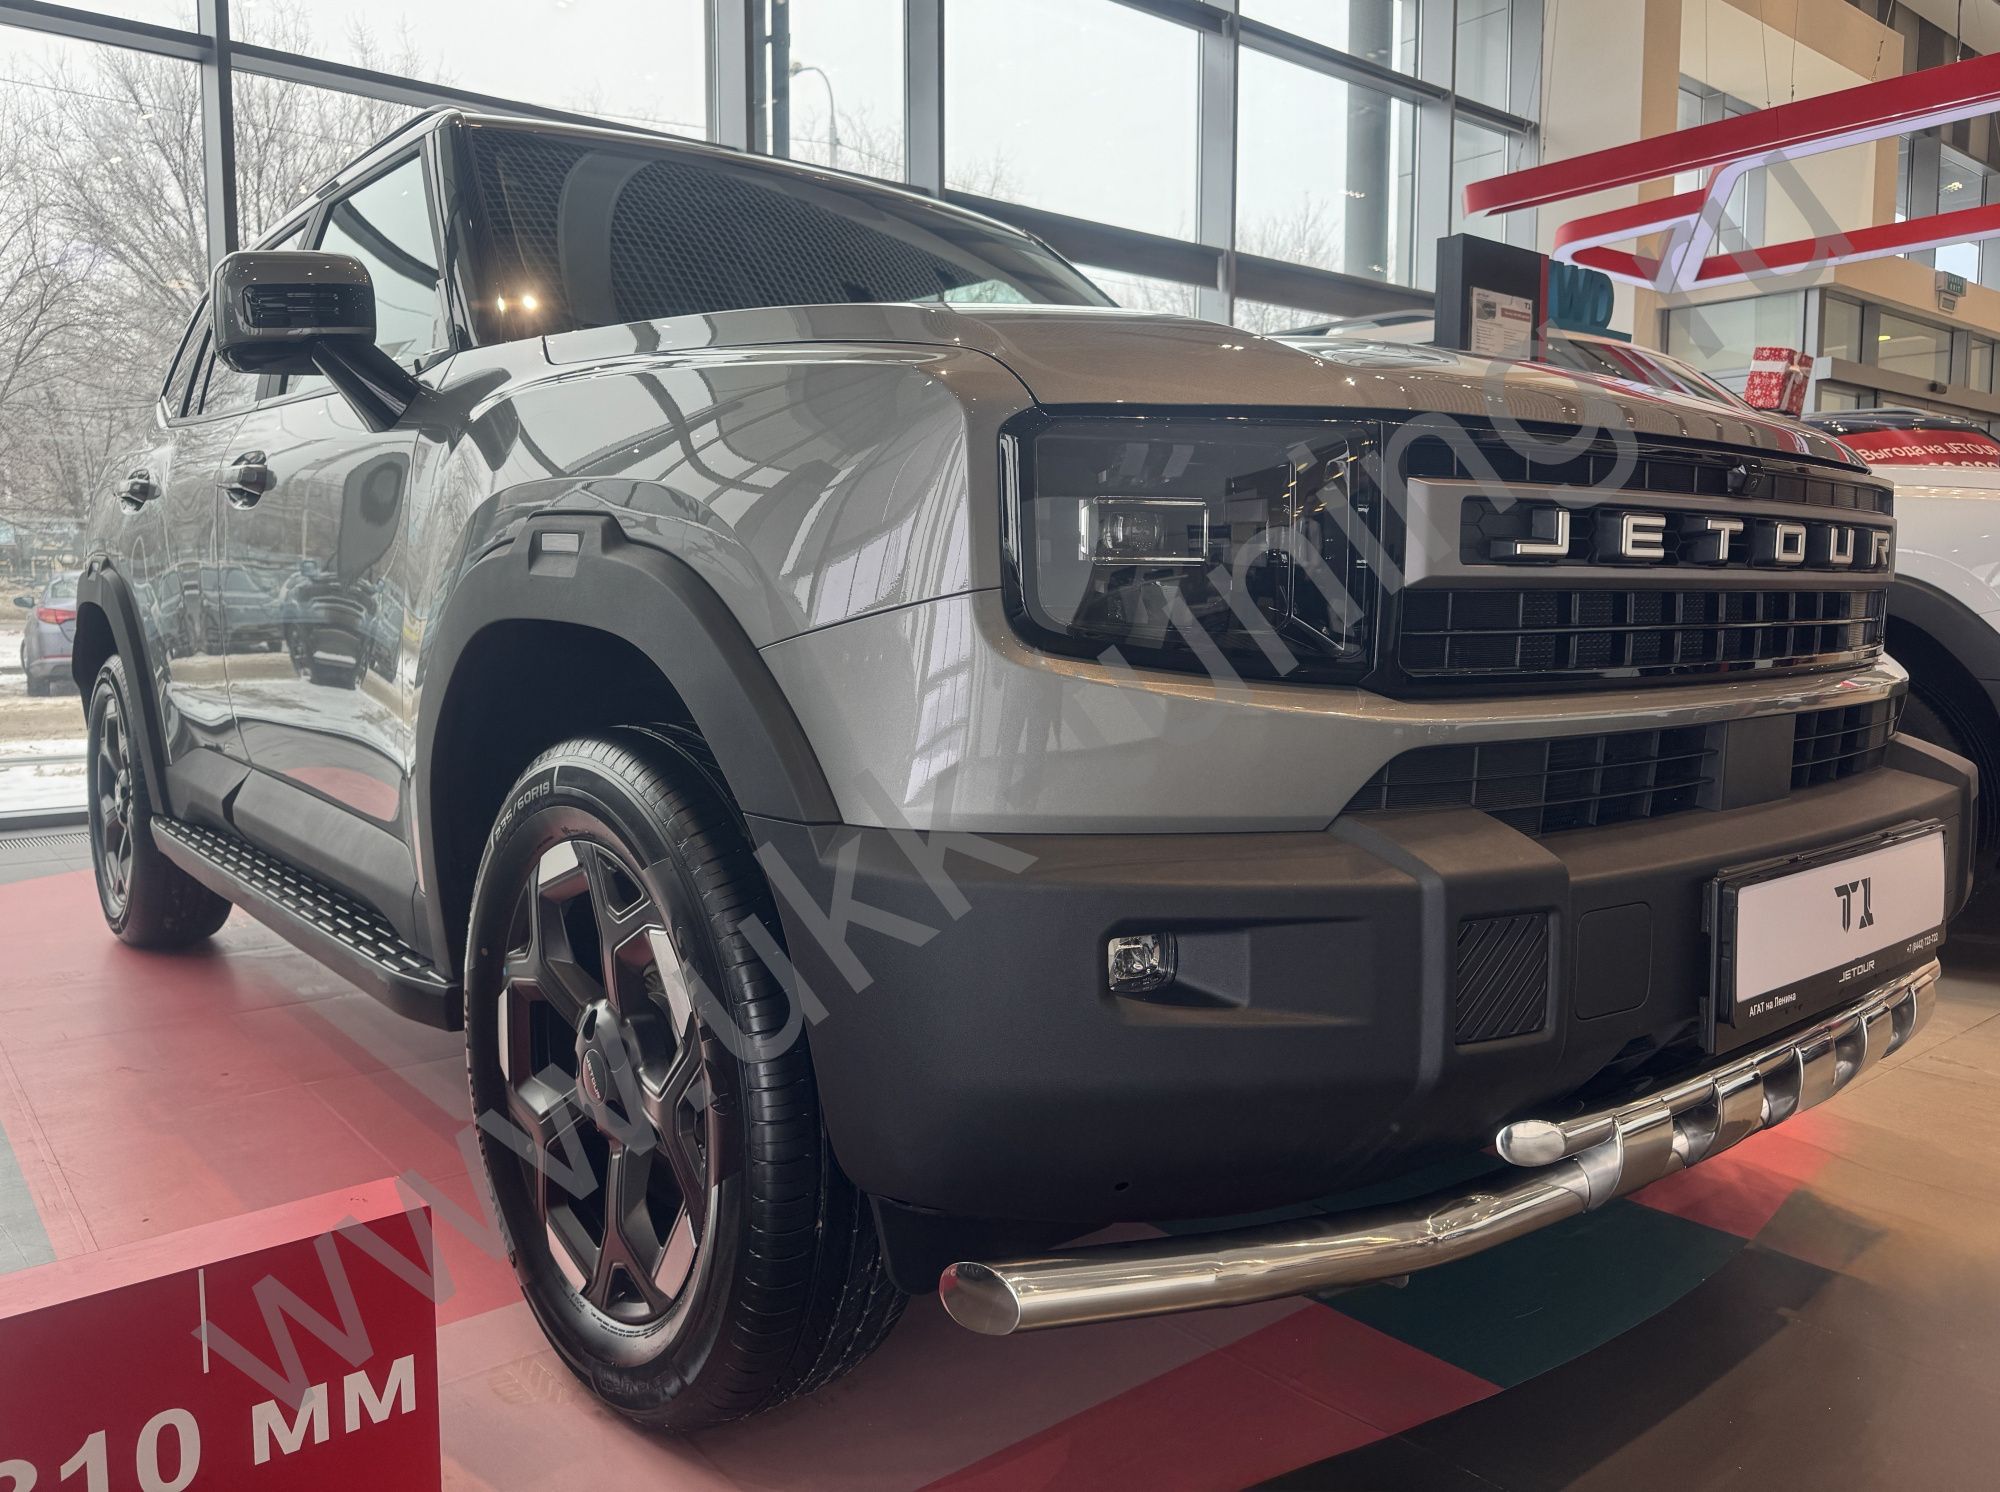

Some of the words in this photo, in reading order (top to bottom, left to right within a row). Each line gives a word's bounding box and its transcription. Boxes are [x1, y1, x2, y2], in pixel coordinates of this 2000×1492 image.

[1856, 445, 1926, 461] Выгода
[1923, 443, 1946, 455] на
[1945, 442, 2000, 456] JETOUR
[1514, 508, 1890, 567] JETOUR
[495, 781, 550, 841] 235/60R19
[1833, 876, 1874, 934] T1
[1838, 959, 1875, 983] JETOUR
[1749, 1001, 1765, 1018] АГАТ
[1765, 1000, 1774, 1011] на
[1774, 992, 1797, 1009] Ленина
